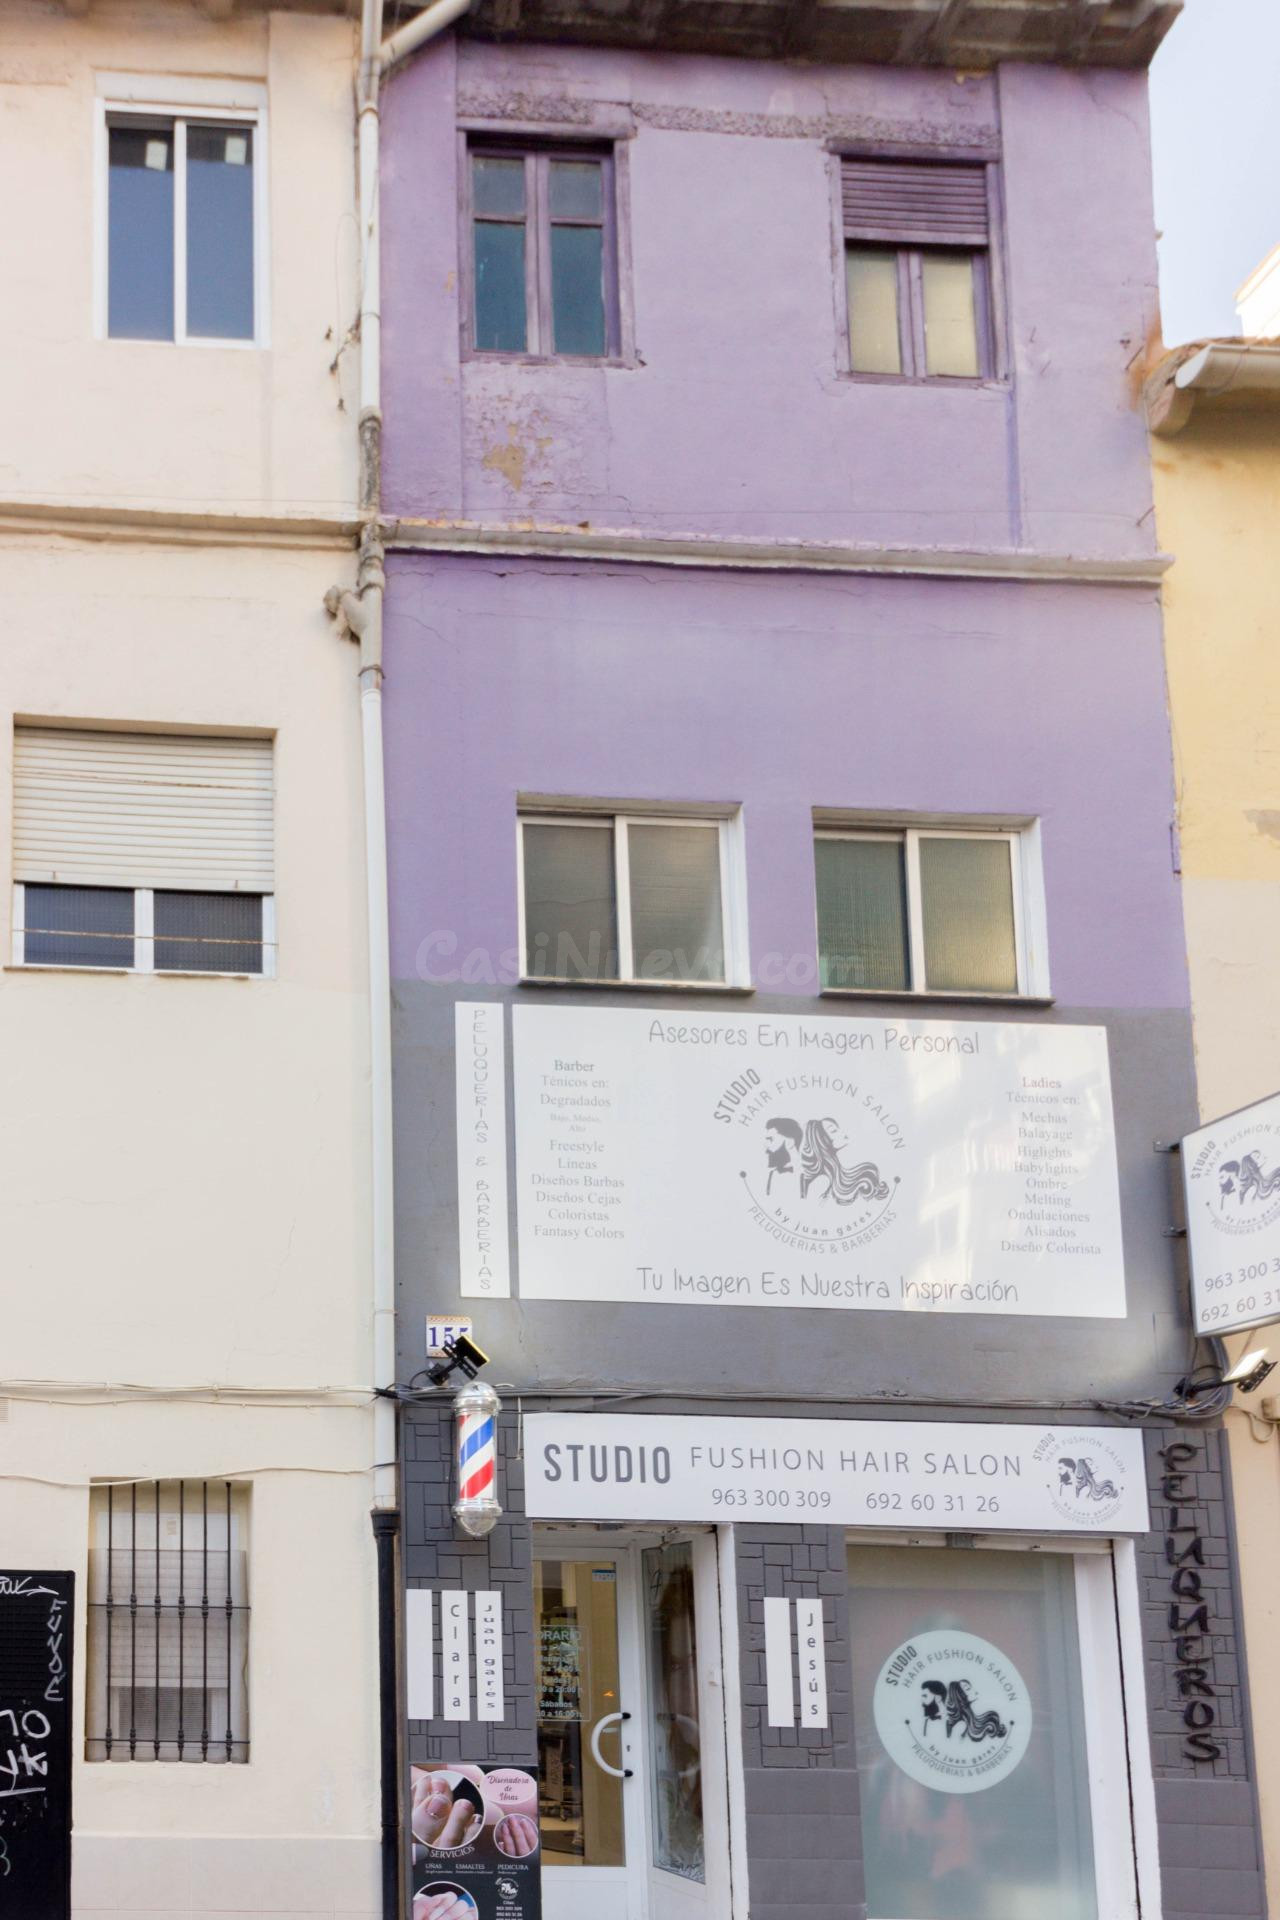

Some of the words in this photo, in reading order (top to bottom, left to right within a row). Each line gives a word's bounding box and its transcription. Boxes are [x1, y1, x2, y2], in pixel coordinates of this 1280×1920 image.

[649, 1019, 747, 1047] Asesores
[757, 1024, 789, 1048] En
[798, 1025, 875, 1056] Imagen
[884, 1028, 980, 1055] Personal
[473, 1009, 489, 1144] PELUQUERIAS
[554, 1059, 596, 1073] Barber
[713, 1067, 761, 1124] STUDIO
[1022, 1076, 1062, 1089] Ladies
[540, 1093, 611, 1108] Degradados
[738, 1089, 773, 1127] HAIR
[775, 1074, 859, 1098] FUSHION
[861, 1094, 906, 1151] SALON
[1021, 1111, 1068, 1124] Mechas
[549, 1138, 605, 1154] Freestyle
[1018, 1127, 1073, 1142] Balayage
[1190, 1139, 1217, 1180] STUDIO
[531, 1172, 580, 1187] Diseños
[583, 1175, 625, 1188] Barbas
[535, 1189, 584, 1204] Diseños
[587, 1191, 622, 1207] Cejas
[1024, 1192, 1072, 1208] Melting
[547, 1207, 610, 1221] Coloristas
[774, 1207, 790, 1225] by
[794, 1221, 829, 1237] juan
[836, 1210, 873, 1237] gares
[1008, 1207, 1091, 1222] Ondulaciones
[476, 1180, 493, 1291] BARBERIAS
[534, 1224, 579, 1239] Fantasy
[584, 1226, 625, 1239] Colors
[747, 1205, 826, 1255] PELUQUERIAS
[841, 1208, 898, 1254] BARBERIAS
[1024, 1224, 1076, 1239] Alisados
[1000, 1239, 1043, 1253] Diseño
[1046, 1241, 1102, 1255] Colorista
[636, 1267, 663, 1292] Tu
[673, 1268, 751, 1299] Imagen
[761, 1271, 791, 1296] Es
[801, 1274, 891, 1299] Nuestra
[900, 1274, 1019, 1302] Inspiración
[1204, 1271, 1233, 1292] 963
[1238, 1261, 1268, 1284] 300
[1201, 1303, 1230, 1322] 692
[1236, 1296, 1256, 1313] 60
[543, 1443, 672, 1485] STUDIO
[690, 1445, 825, 1472] FUSHION
[840, 1450, 910, 1474] HAIR
[924, 1452, 1022, 1477] SALON
[711, 1488, 748, 1506] 963
[753, 1488, 790, 1507] 300
[795, 1489, 832, 1508] 309
[865, 1492, 903, 1510] 692
[911, 1494, 936, 1511] 60
[944, 1495, 965, 1511] 31
[976, 1496, 1001, 1513] 26
[484, 1604, 496, 1645] Juan
[450, 1604, 461, 1708] Clara
[806, 1612, 818, 1716] Jesús
[885, 1644, 918, 1687] STUDIO
[484, 1658, 497, 1709] gares
[902, 1662, 926, 1689] HAIR
[926, 1647, 985, 1666] FUSHION
[986, 1661, 1017, 1702] SALON
[911, 1742, 966, 1778] PELUQUERIAS
[429, 1845, 476, 1859] SERVICIOS
[455, 1863, 486, 1871] ESMALTES
[497, 1863, 529, 1872] PEDICURA
